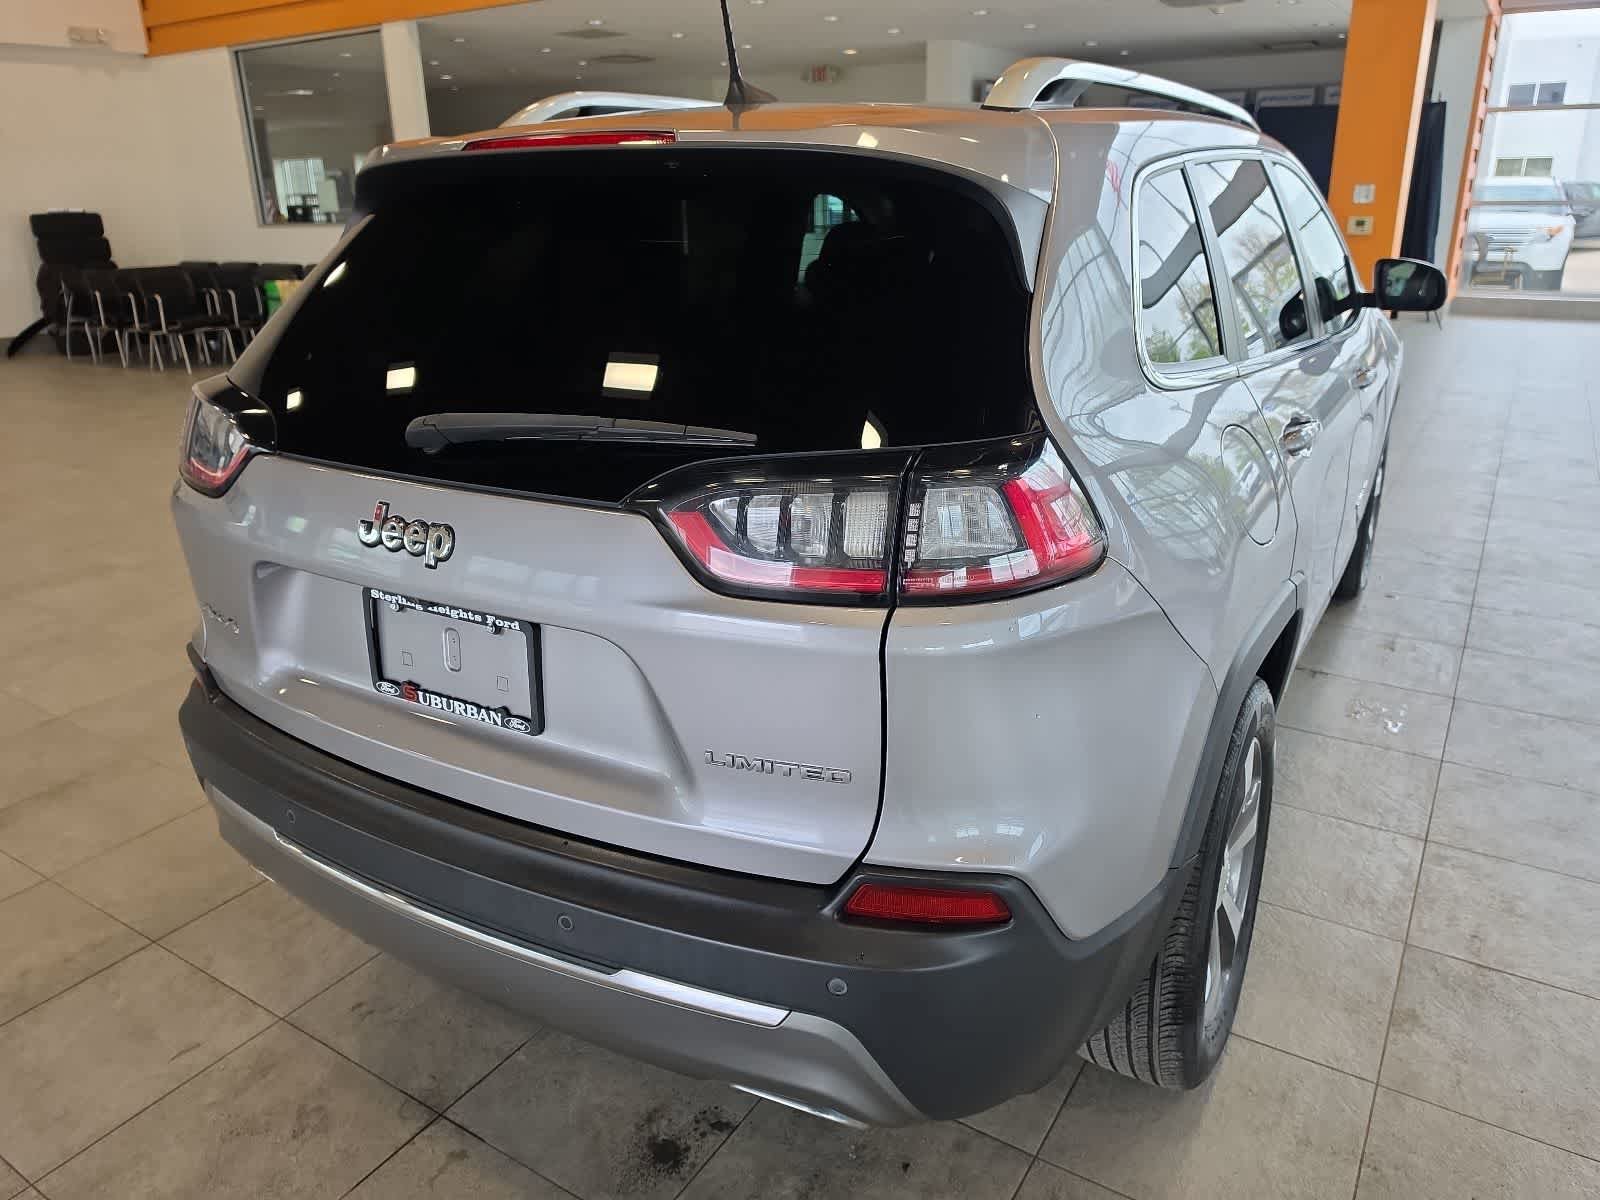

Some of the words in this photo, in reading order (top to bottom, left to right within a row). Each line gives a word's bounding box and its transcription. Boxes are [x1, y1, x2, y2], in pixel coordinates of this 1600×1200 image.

[358, 500, 455, 569] Jeep
[485, 615, 520, 630] Ford
[379, 683, 398, 695] Ford
[402, 685, 502, 726] SUBURBAN
[507, 719, 528, 732] Ford
[704, 749, 852, 784] LIMITED
